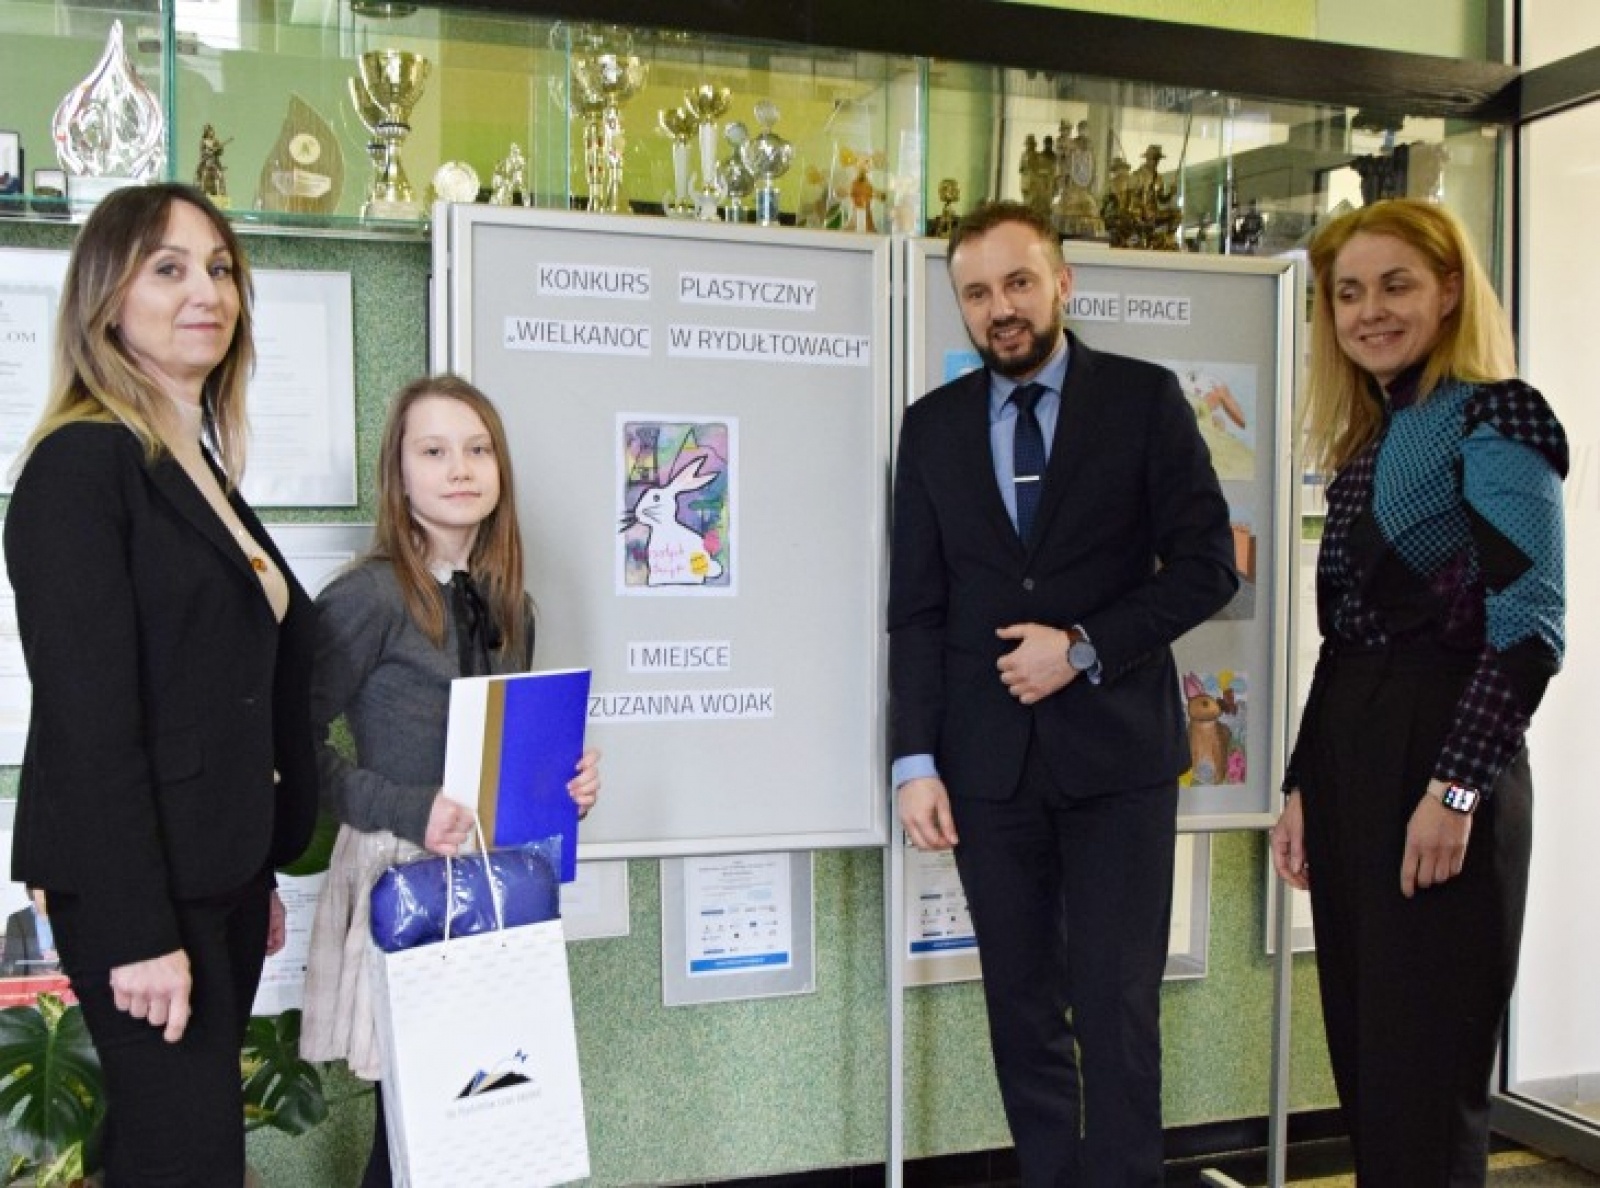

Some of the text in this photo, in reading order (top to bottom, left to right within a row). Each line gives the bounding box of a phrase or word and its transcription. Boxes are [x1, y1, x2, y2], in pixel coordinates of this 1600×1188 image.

[540, 268, 815, 305] KONKURS PLASTYCZNY
[1128, 299, 1188, 321] PRACE
[670, 328, 691, 347] W
[642, 647, 728, 668] MIEJSCE
[589, 693, 772, 717] ZUZANNA WOJAK
